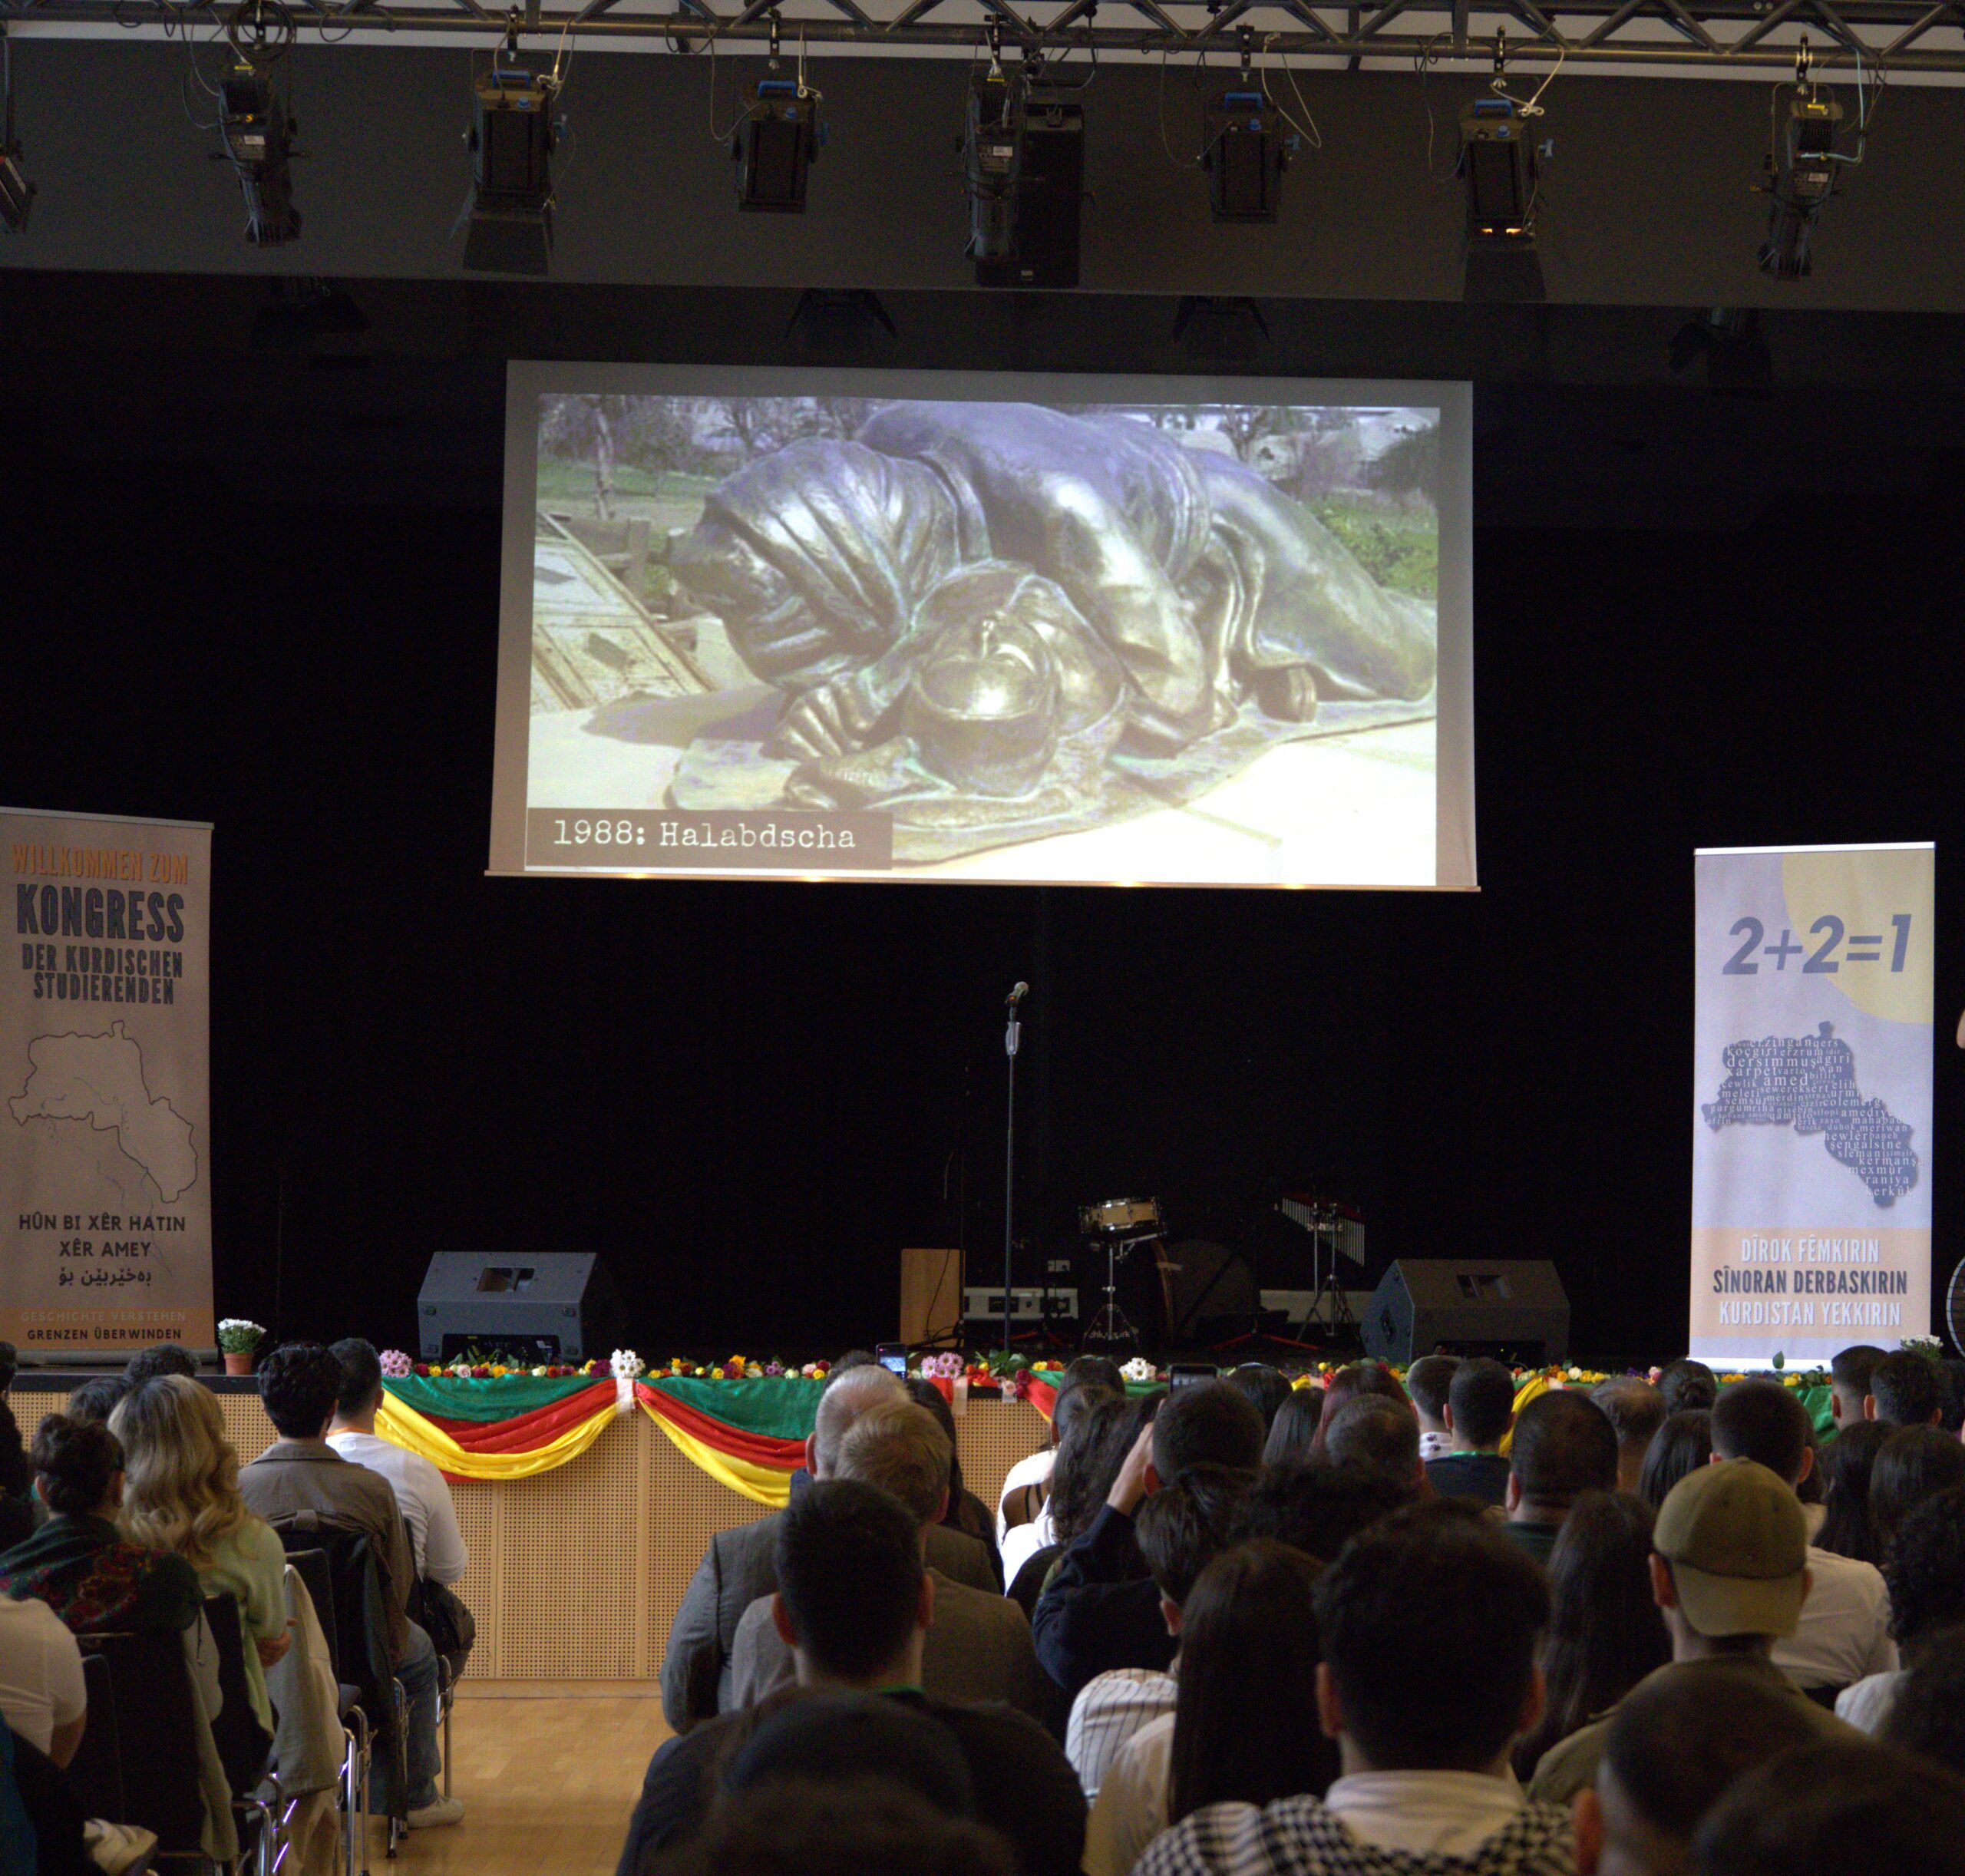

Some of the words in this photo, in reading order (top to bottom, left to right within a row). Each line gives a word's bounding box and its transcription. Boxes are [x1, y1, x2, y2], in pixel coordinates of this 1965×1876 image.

[553, 819, 645, 845] 1988:
[659, 822, 856, 848] Halabdscha
[12, 844, 143, 881] WILLKOMMEN
[150, 852, 188, 884] ZUM
[17, 884, 184, 943] KONGRESS
[1722, 913, 1912, 975] 2+2=1
[22, 943, 57, 972] DER
[65, 945, 183, 978] KURDISCHEN
[34, 972, 174, 1005] STUDIERENDEN
[1727, 1054, 1783, 1067] dersim
[1763, 1072, 1808, 1085] amed
[19, 1211, 56, 1230] HÛN
[64, 1215, 81, 1230] BI
[88, 1212, 121, 1231] XÊR
[129, 1216, 186, 1231] HATIN
[59, 1238, 94, 1257] XÊR
[101, 1241, 151, 1257] AMEY
[1741, 1234, 1792, 1263] DÎROK
[1798, 1234, 1880, 1263] FÊMKIRIN
[1713, 1265, 1786, 1293] SÎNORAN
[1794, 1270, 1907, 1294] DERBASKIRIN
[21, 1311, 104, 1322] GESCHICHTE
[111, 1311, 186, 1321] VERSTEHEN
[1719, 1300, 1815, 1325] KURDISTAN
[1821, 1302, 1901, 1326] YEKKIRIN
[27, 1329, 88, 1339] GRENZEN
[94, 1326, 181, 1339] ÜBERWINDEN
